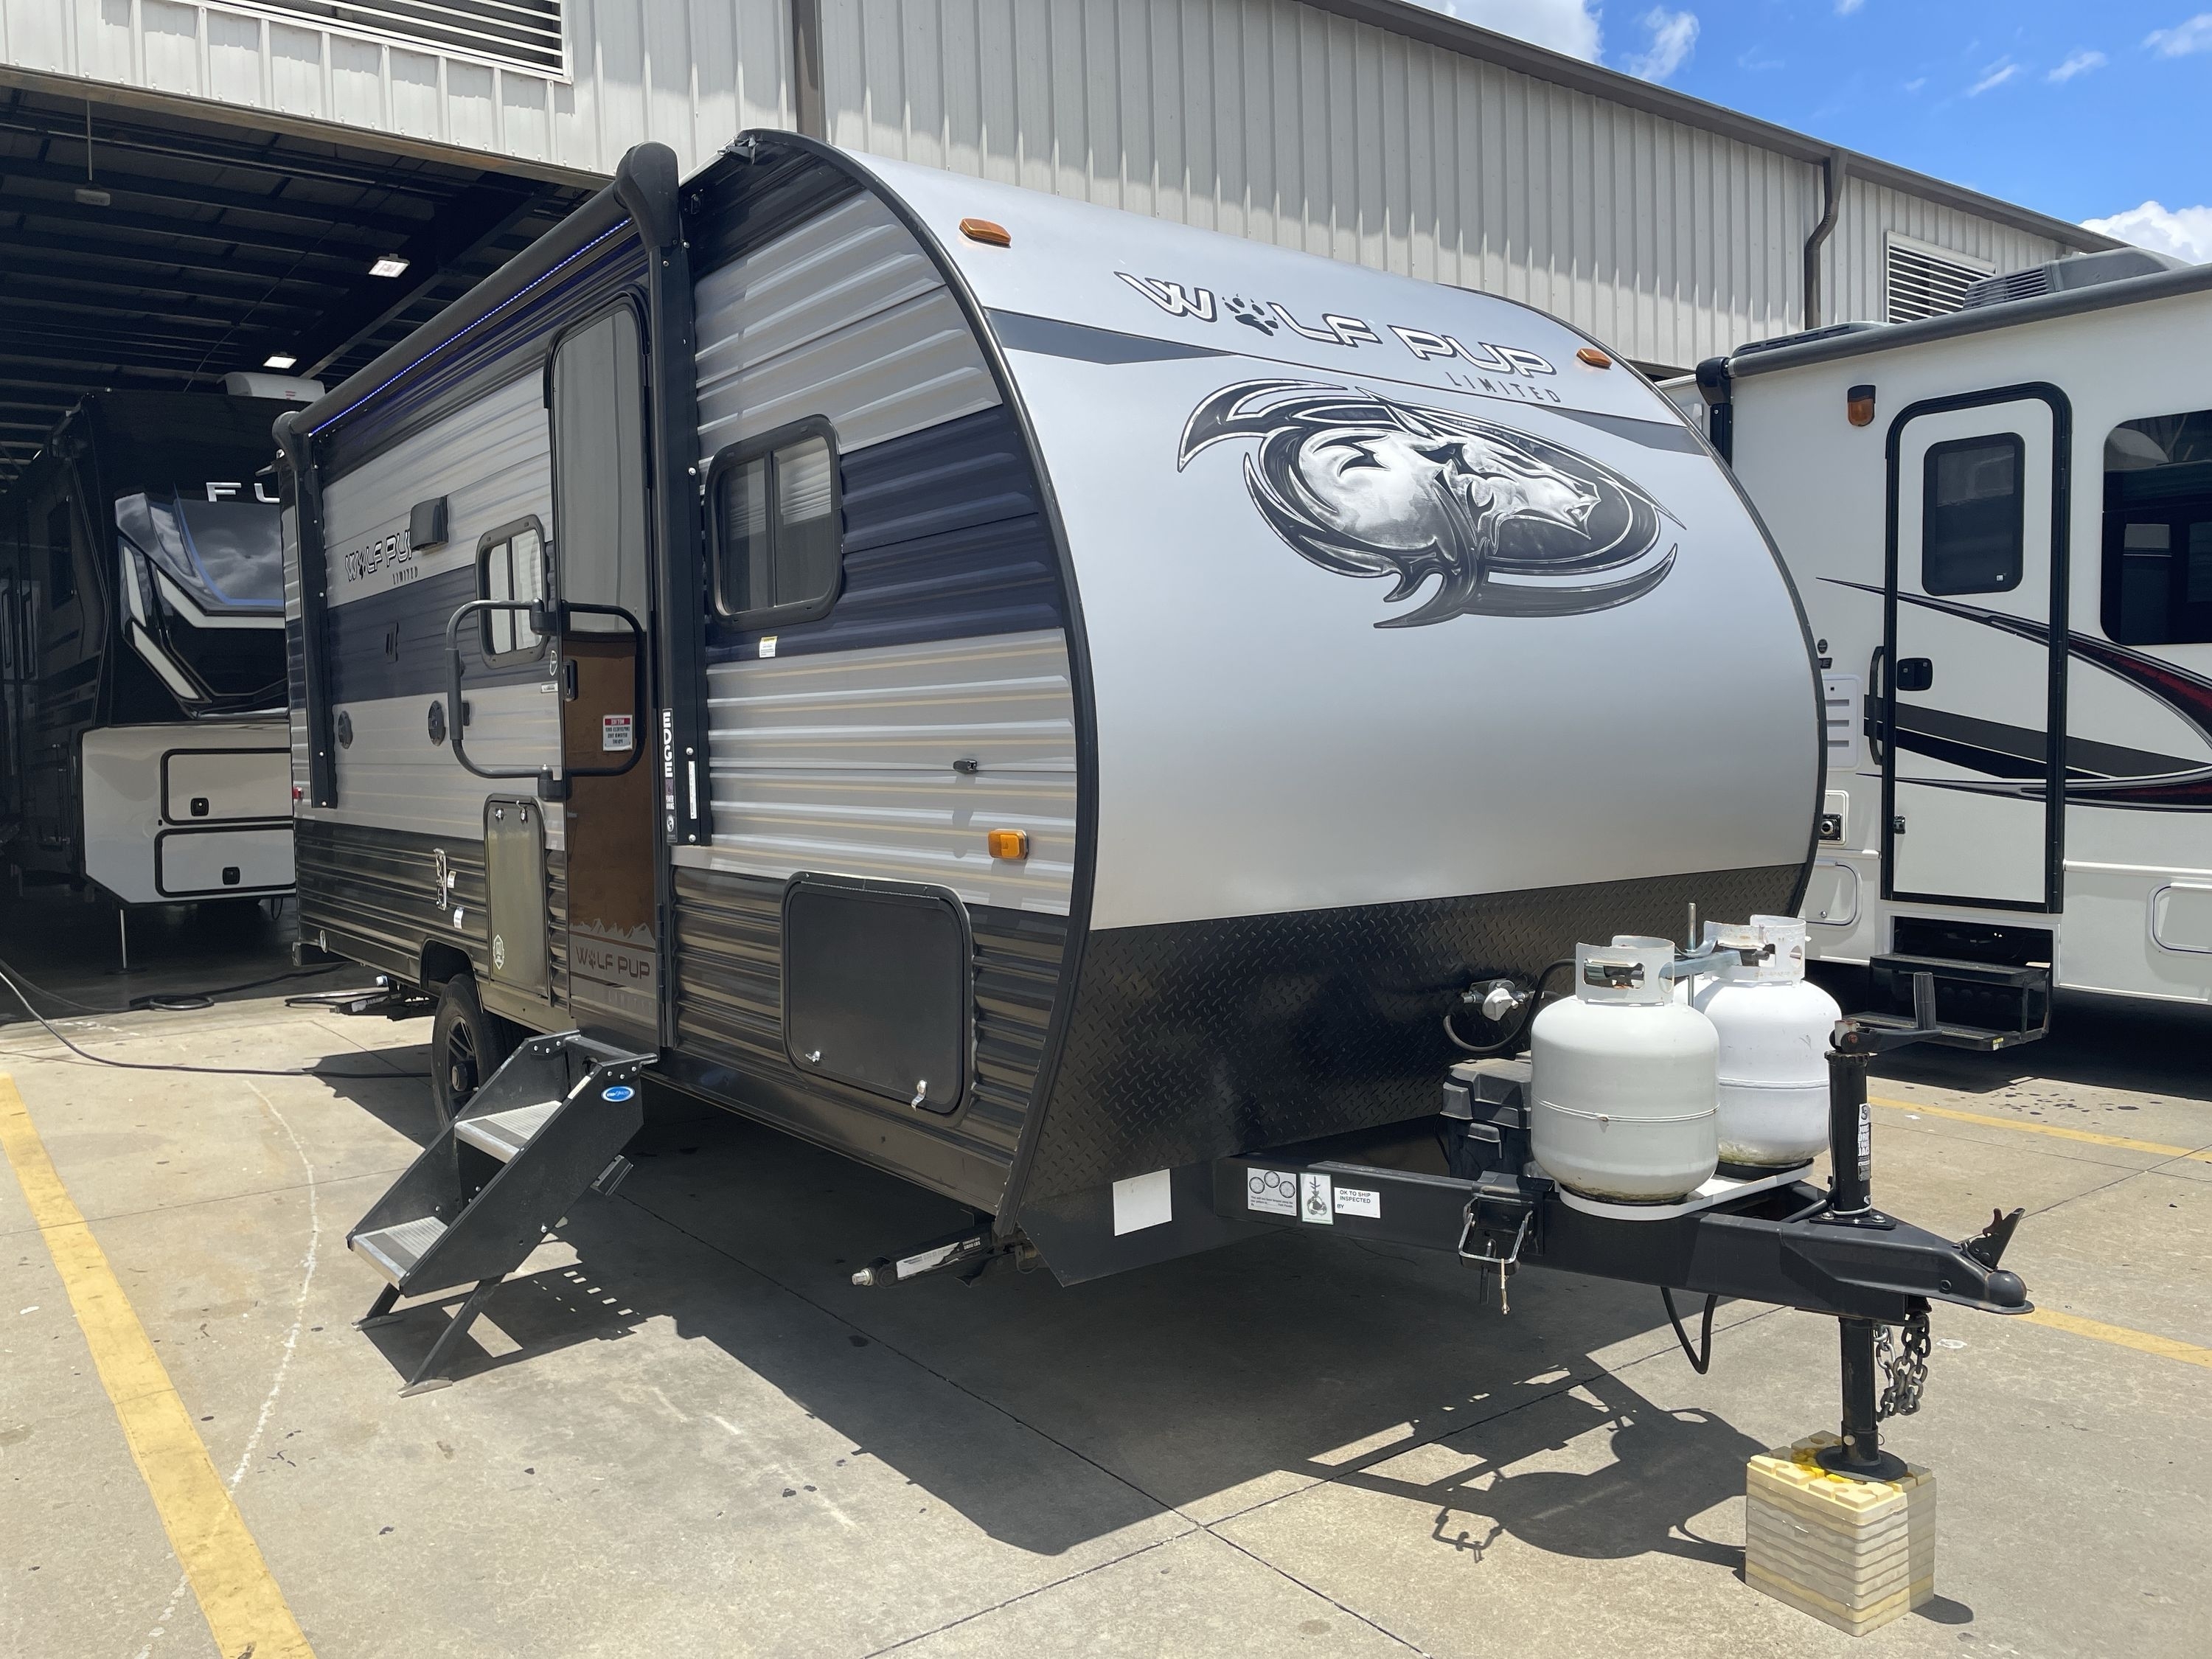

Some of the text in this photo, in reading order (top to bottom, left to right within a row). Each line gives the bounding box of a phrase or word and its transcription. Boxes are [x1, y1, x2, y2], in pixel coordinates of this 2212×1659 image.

[1386, 324, 1557, 378] PUP
[1445, 371, 1561, 403] LIMITED
[392, 566, 418, 585] LIMITED
[663, 712, 673, 777] EDGE
[618, 956, 650, 979] PUP
[1340, 1195, 1371, 1203] INSPECTED
